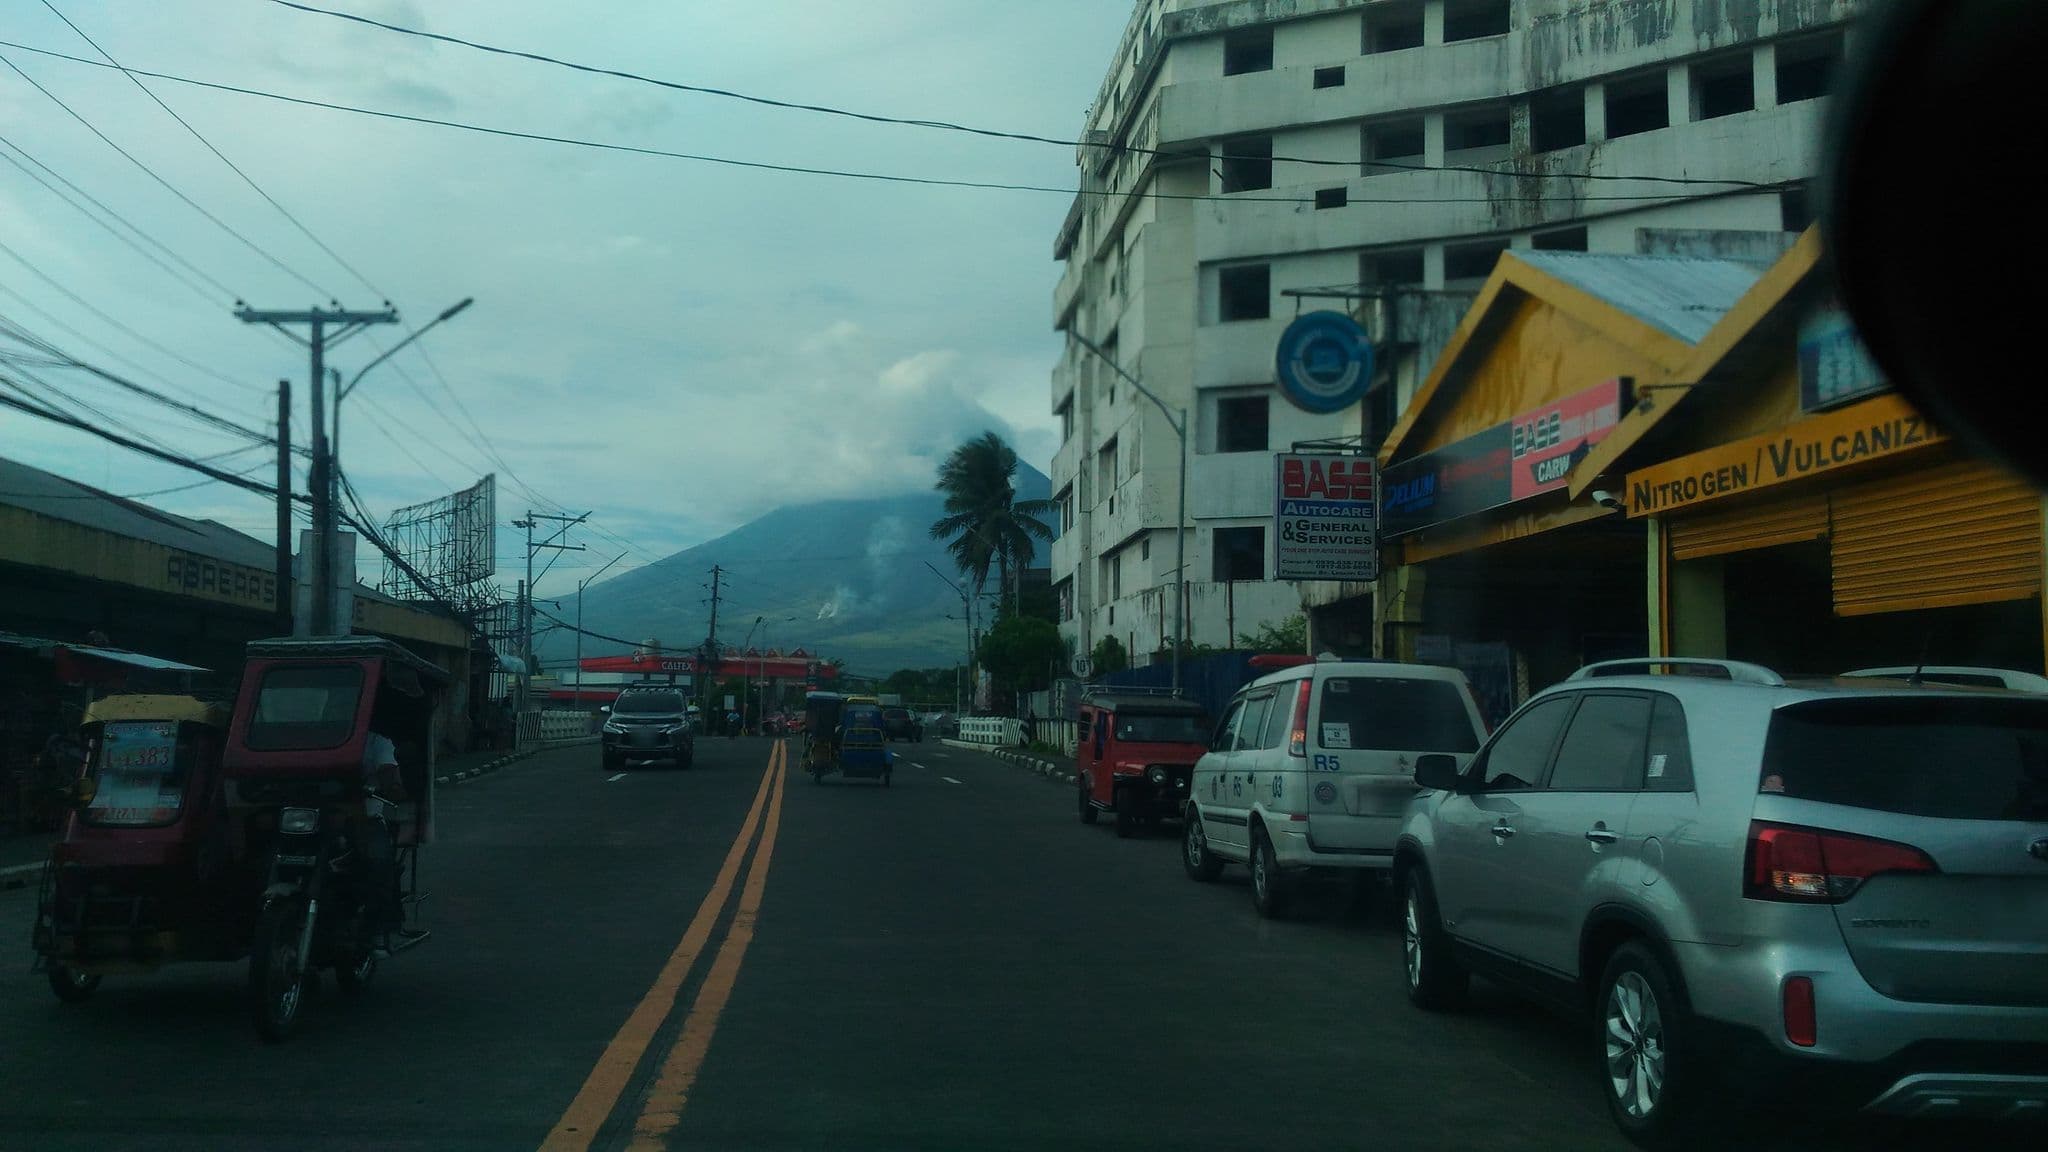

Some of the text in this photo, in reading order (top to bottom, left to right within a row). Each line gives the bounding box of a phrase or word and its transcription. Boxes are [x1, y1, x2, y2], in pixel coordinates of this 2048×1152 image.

[1513, 412, 1561, 459] BASE
[1283, 459, 1372, 500] BASE
[1632, 462, 1747, 513] NITROGEN
[1283, 501, 1373, 517] AUTOCARE
[1282, 519, 1369, 541] & GENERAL
[1295, 531, 1372, 545] SERVICES
[661, 661, 693, 671] CALTEX
[1314, 754, 1340, 771] R5
[1851, 919, 1931, 929] SORENTO
